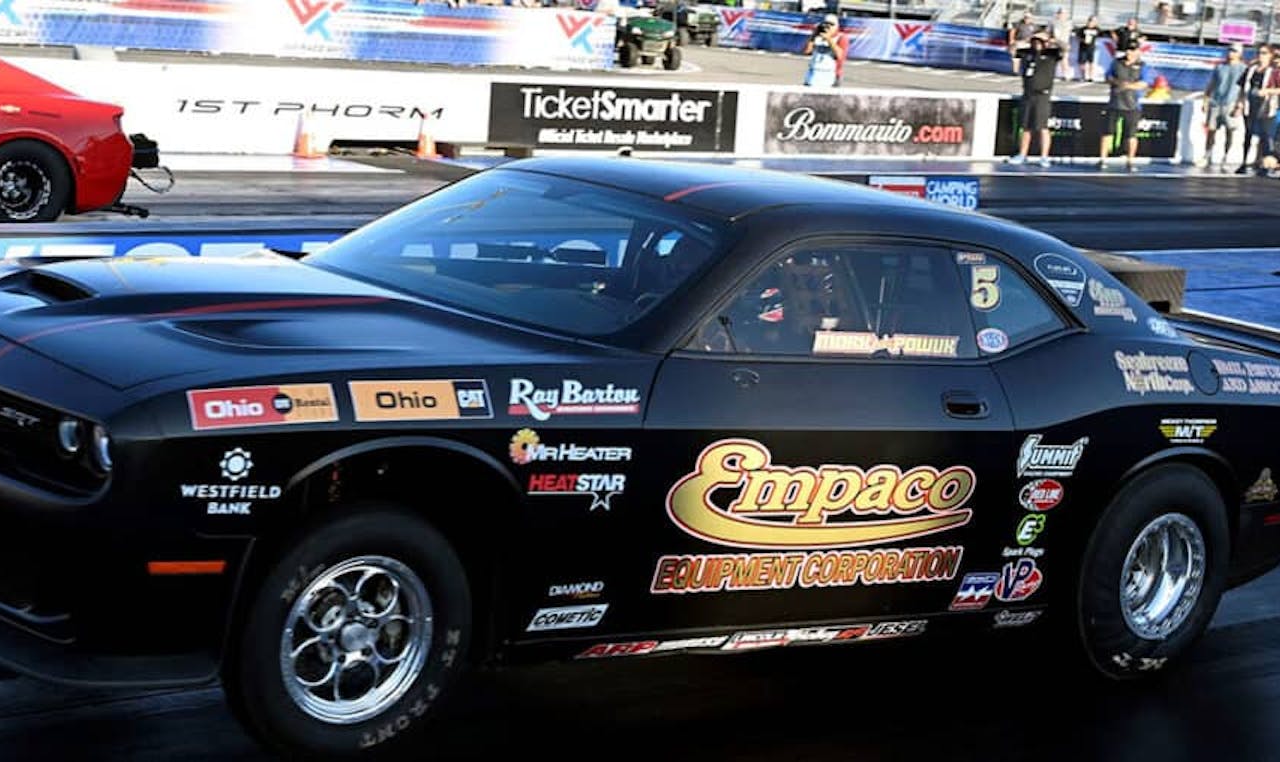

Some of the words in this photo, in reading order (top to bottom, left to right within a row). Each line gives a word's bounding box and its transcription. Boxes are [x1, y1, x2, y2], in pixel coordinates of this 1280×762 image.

[177, 98, 261, 115] 1ST
[273, 101, 445, 119] PHORM
[521, 87, 713, 123] TicketSmarter
[926, 180, 977, 196] CAMPING
[969, 264, 1002, 313] 5
[204, 399, 264, 420] Ohio
[375, 391, 437, 410] Ohio
[509, 378, 559, 421] Ray
[561, 379, 640, 404] Barton
[558, 443, 633, 461] HEATER
[180, 484, 281, 499] WESTFIELD
[667, 439, 976, 549] Empaco
[207, 502, 252, 515] BANK
[651, 551, 806, 592] EQUIPMENT
[800, 547, 963, 587] CORPORATION
[548, 581, 604, 596] DIAMOND
